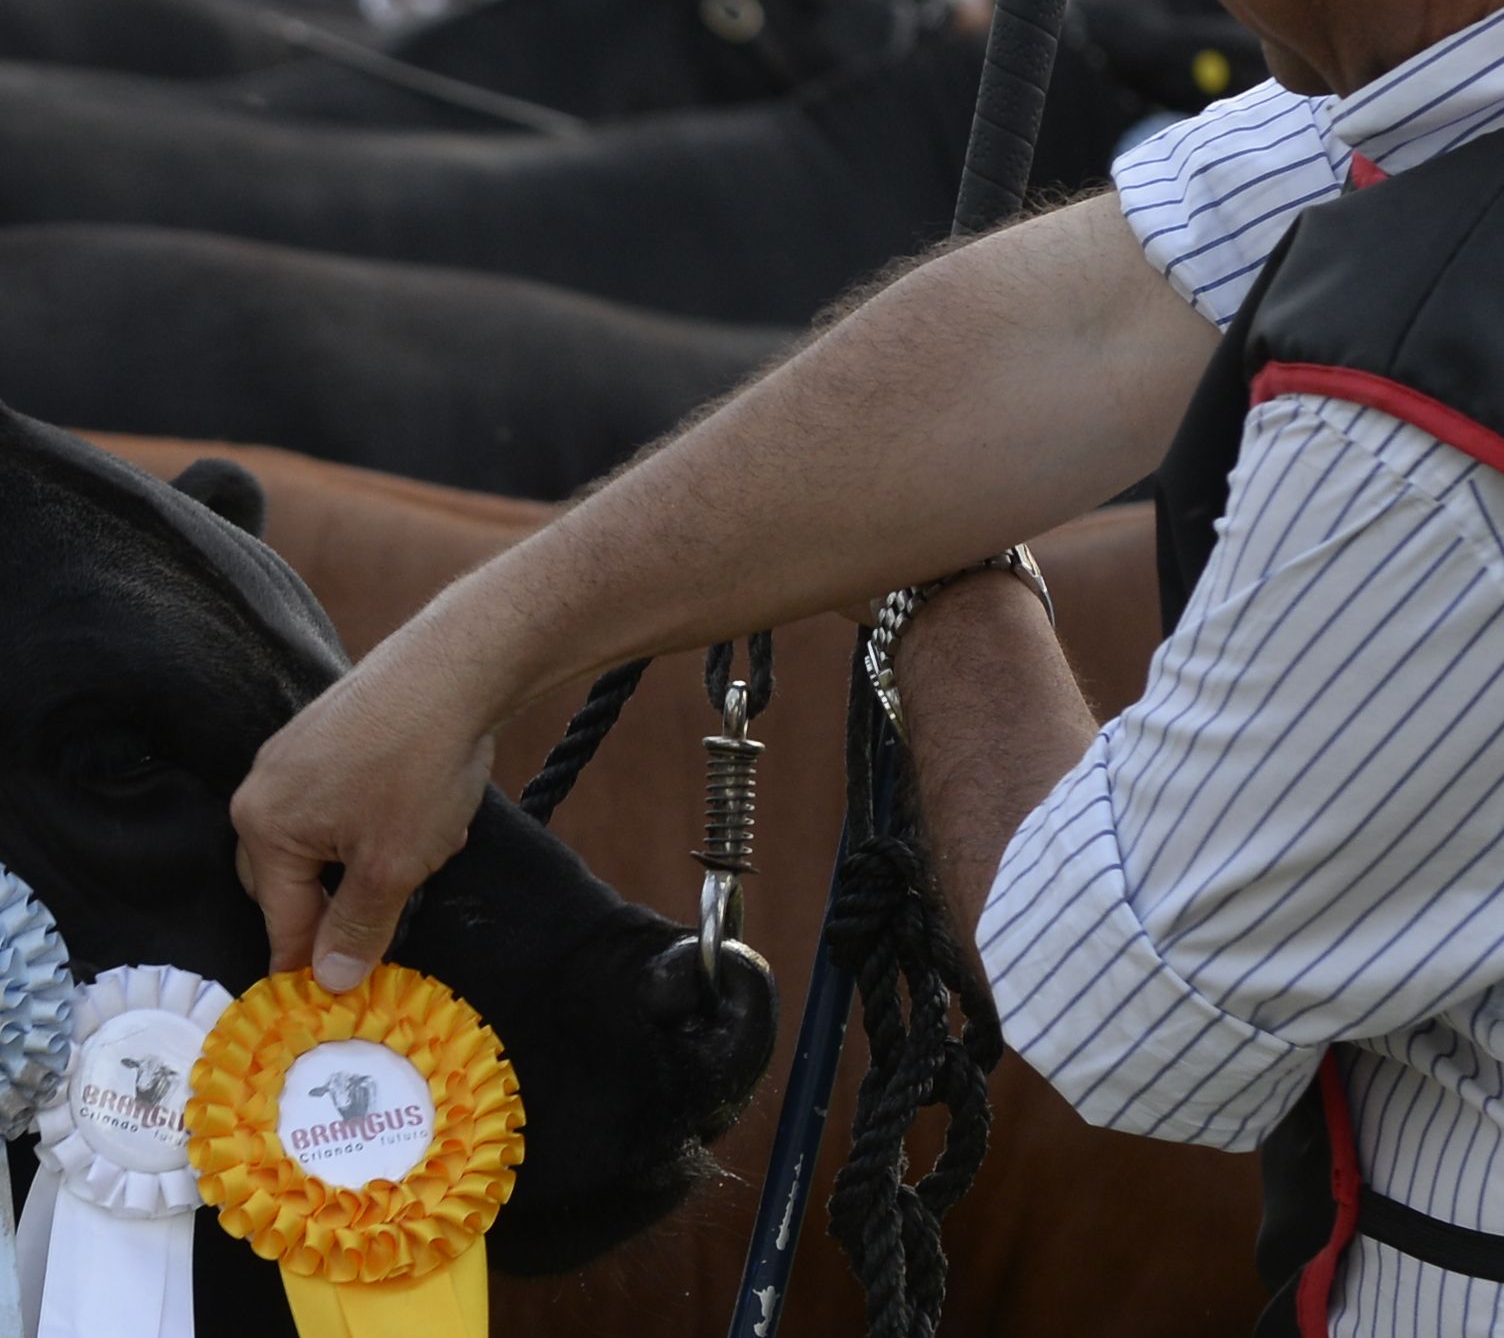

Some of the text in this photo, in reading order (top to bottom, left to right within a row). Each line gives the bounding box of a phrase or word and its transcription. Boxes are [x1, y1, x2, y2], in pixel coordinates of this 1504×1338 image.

[79, 1106, 139, 1133] Criando
[82, 1084, 192, 1136] BRANGU
[291, 1105, 424, 1151] BRANGUS
[299, 1128, 428, 1164] Criando futuro
